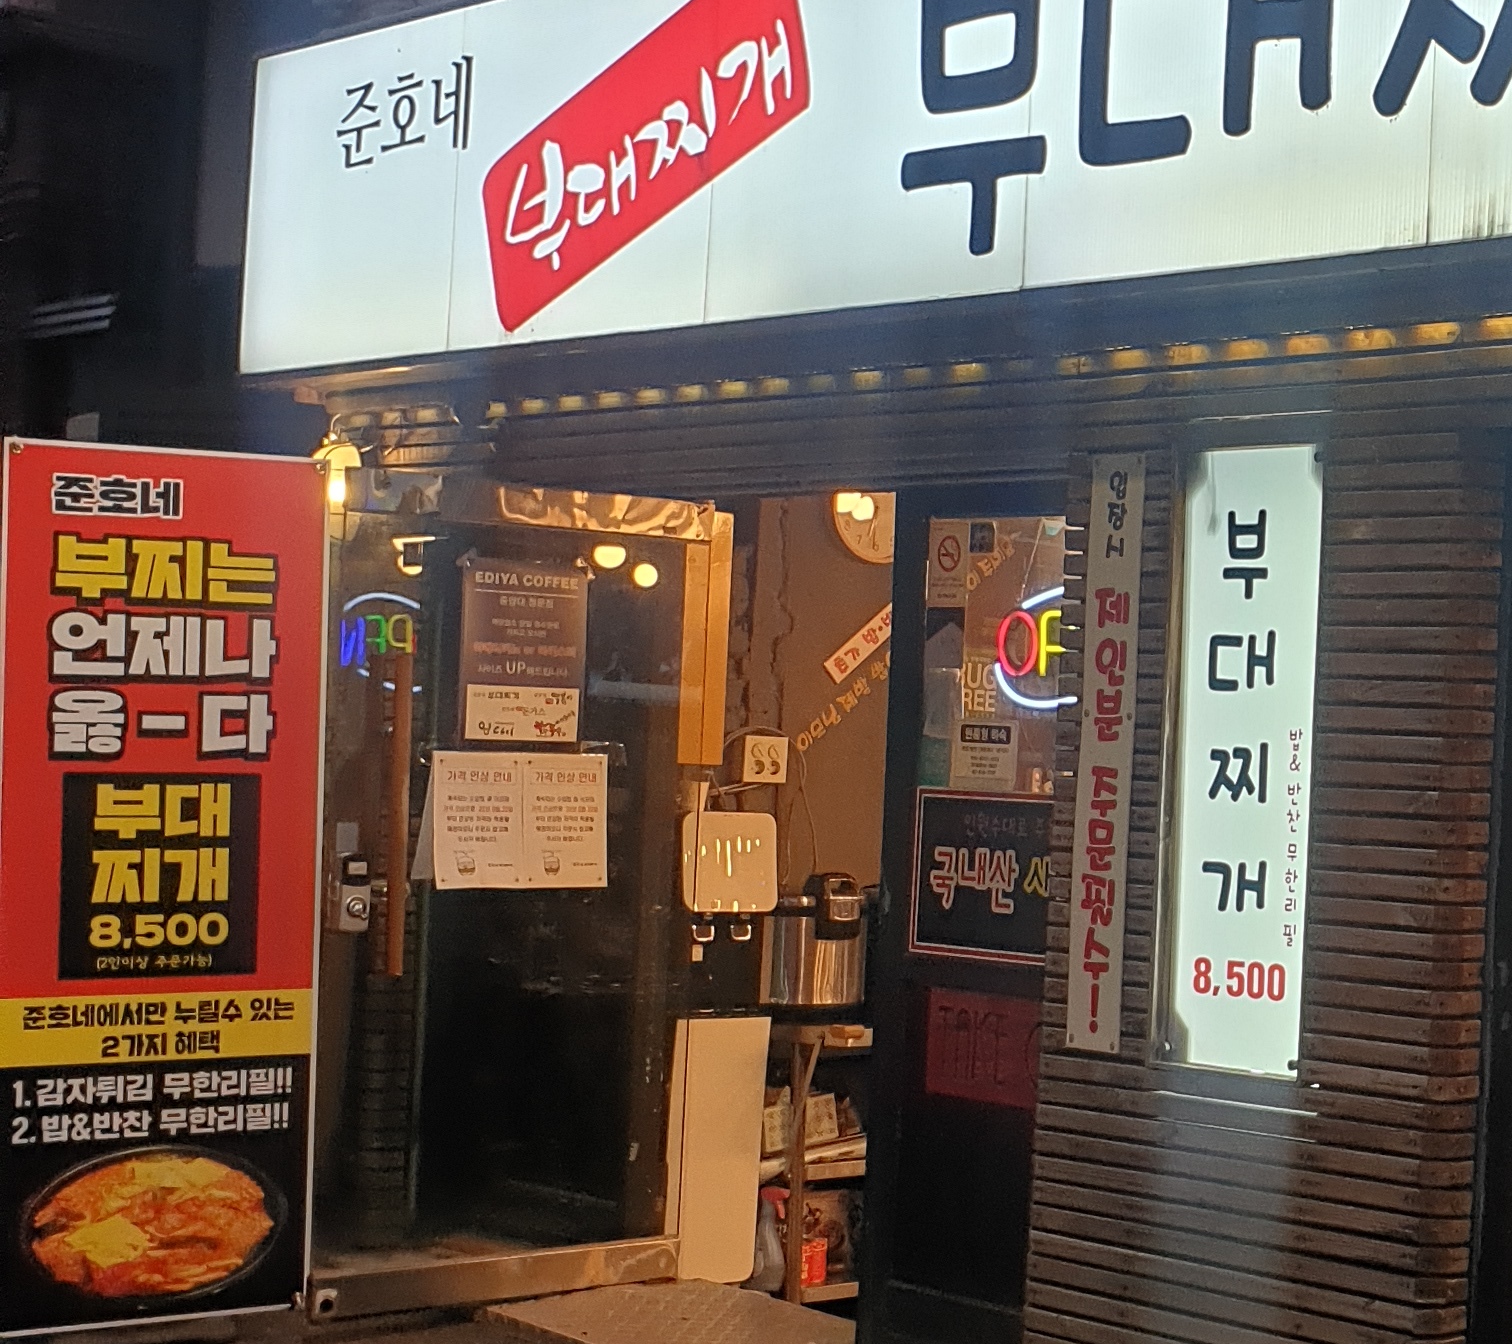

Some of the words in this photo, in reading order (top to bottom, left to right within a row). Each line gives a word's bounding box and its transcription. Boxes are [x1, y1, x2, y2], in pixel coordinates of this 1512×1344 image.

[335, 54, 474, 170] 준호네
[504, 18, 793, 271] 부대찌개
[52, 474, 183, 518] 준호네
[54, 533, 278, 606] 부찌는
[475, 571, 519, 586] EDIYA
[522, 574, 579, 590] COFFEE
[51, 610, 278, 679] 언제나
[1201, 508, 1278, 914] 부대찌개
[93, 782, 232, 839] 부대
[90, 846, 232, 904] 찌개
[930, 845, 1020, 915] 국내산
[88, 912, 230, 951] 8,500
[1191, 956, 1287, 1004] 8,500
[22, 1001, 168, 1031] 준호네에서만
[249, 996, 295, 1022] 있는
[101, 1031, 168, 1058] 2가지
[174, 1029, 221, 1055] 혜택
[35, 1073, 154, 1108] 감자튀김
[163, 1066, 294, 1100] 무한리필!!
[41, 1109, 153, 1144] 밥&반찬
[159, 1101, 290, 1135] 무한리필!!
